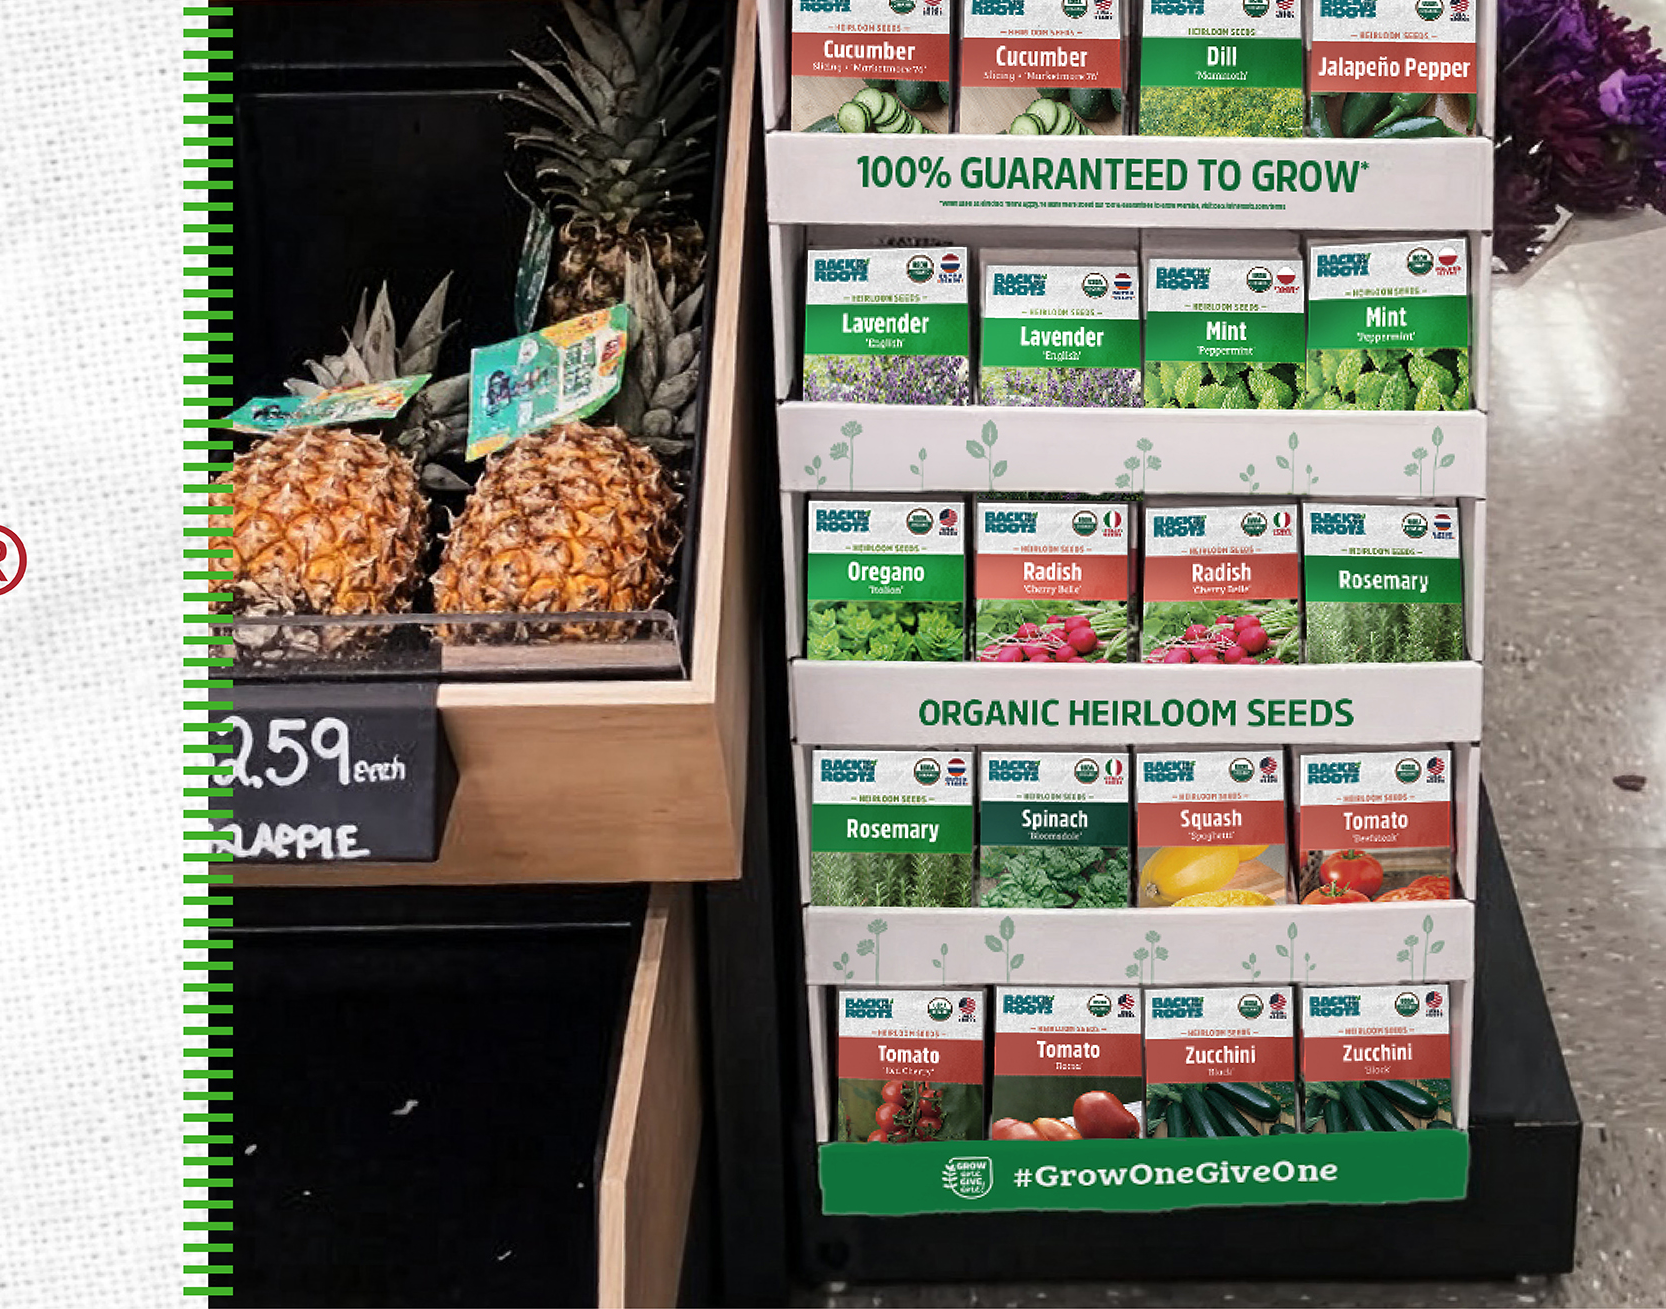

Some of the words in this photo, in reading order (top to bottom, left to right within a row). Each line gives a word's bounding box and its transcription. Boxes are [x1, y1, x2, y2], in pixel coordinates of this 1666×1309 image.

[823, 40, 916, 61] Cucumber
[996, 46, 1088, 67] Cucumber
[1207, 46, 1237, 66] Dill
[1318, 55, 1400, 79] Jalapeño
[1405, 58, 1471, 80] Pepper
[857, 156, 951, 188] 100%
[961, 157, 1187, 191] GUARANTEED
[1198, 159, 1241, 192] TO
[842, 313, 929, 334] Lavender
[1366, 307, 1408, 328] Mint
[1021, 326, 1104, 347] Lavender
[1206, 321, 1247, 341] Mint
[848, 561, 925, 584] Oregano
[1023, 561, 1082, 581] Radish
[1192, 562, 1252, 583] Radish
[1339, 570, 1429, 593] Rosemary
[919, 699, 1059, 727] ORGANIC
[1070, 699, 1236, 726] HEIRLOOM
[1247, 698, 1354, 727] SEEDS
[846, 818, 940, 843] Rosemary
[1022, 809, 1088, 831] Spinach
[1180, 809, 1242, 831] Squash
[1343, 812, 1409, 831] Tomato
[878, 1045, 940, 1064] Tomato
[1036, 1040, 1101, 1059] Tomato
[1185, 1045, 1256, 1065] Zucchini
[1342, 1043, 1413, 1063] Zucchini
[1014, 1160, 1338, 1187] #GrowOneGiveOne
